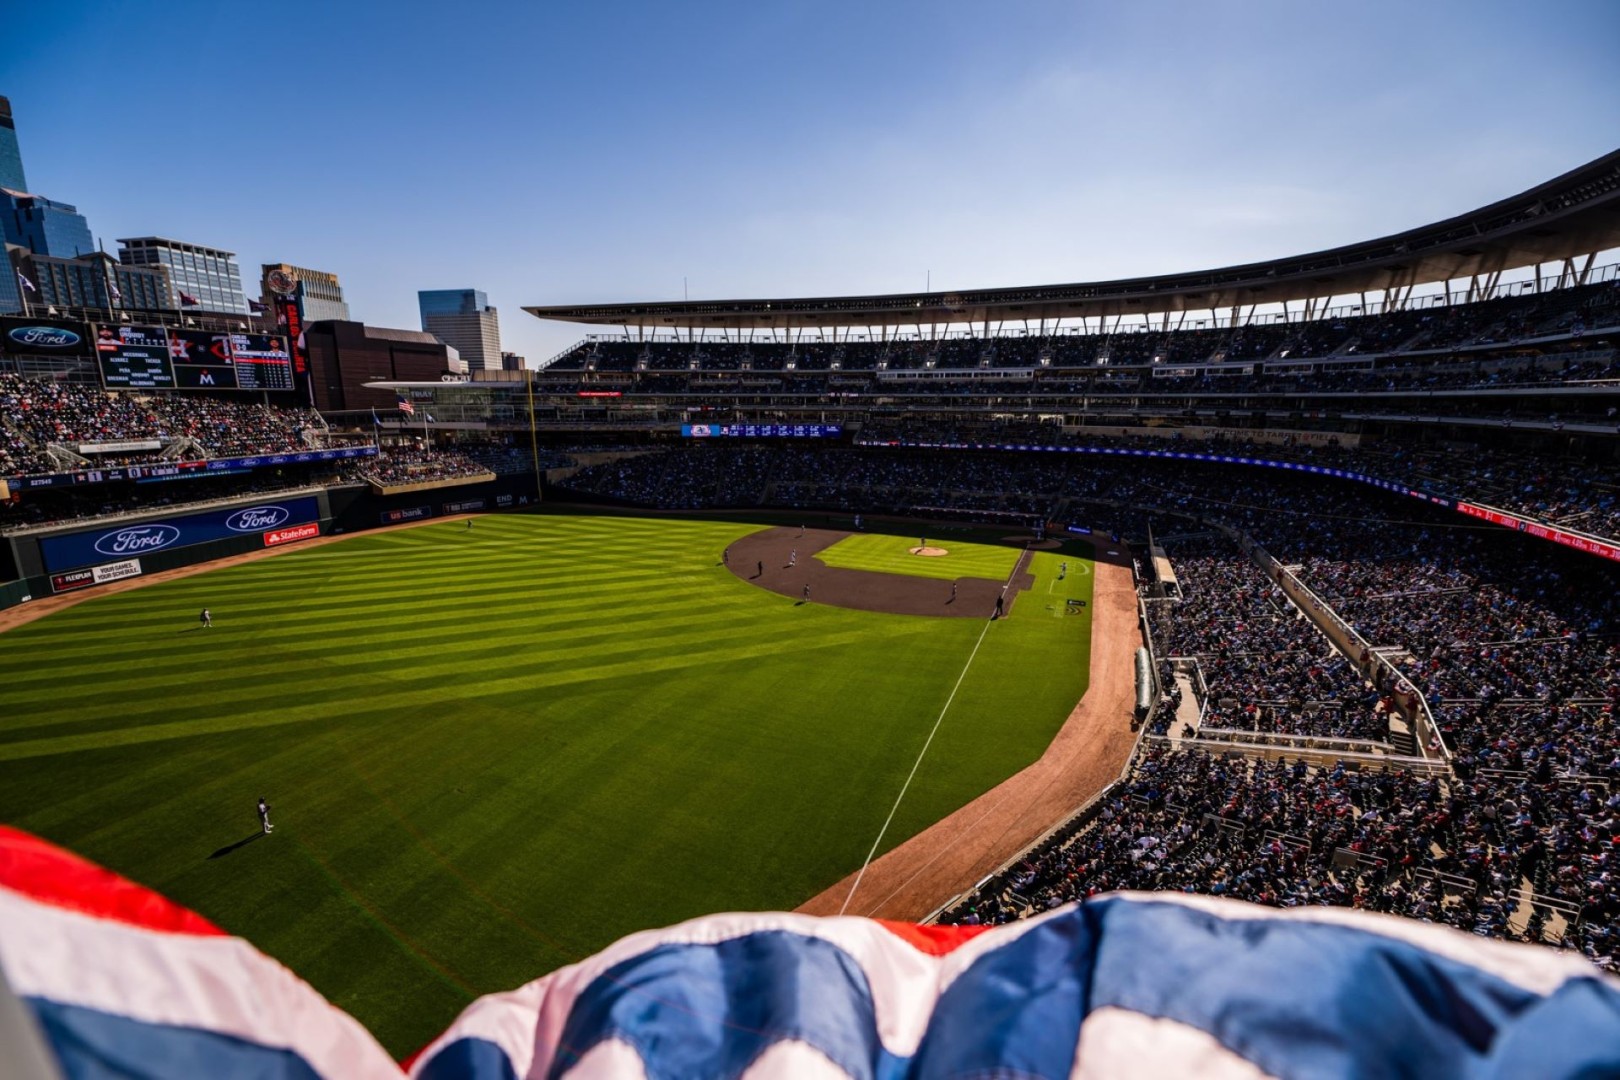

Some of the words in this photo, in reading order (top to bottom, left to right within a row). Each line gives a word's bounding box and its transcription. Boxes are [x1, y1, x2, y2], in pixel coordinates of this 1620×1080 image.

[24, 328, 67, 345] Ford
[240, 509, 277, 529] Ford
[402, 507, 423, 518] bank
[113, 528, 164, 551] Ford
